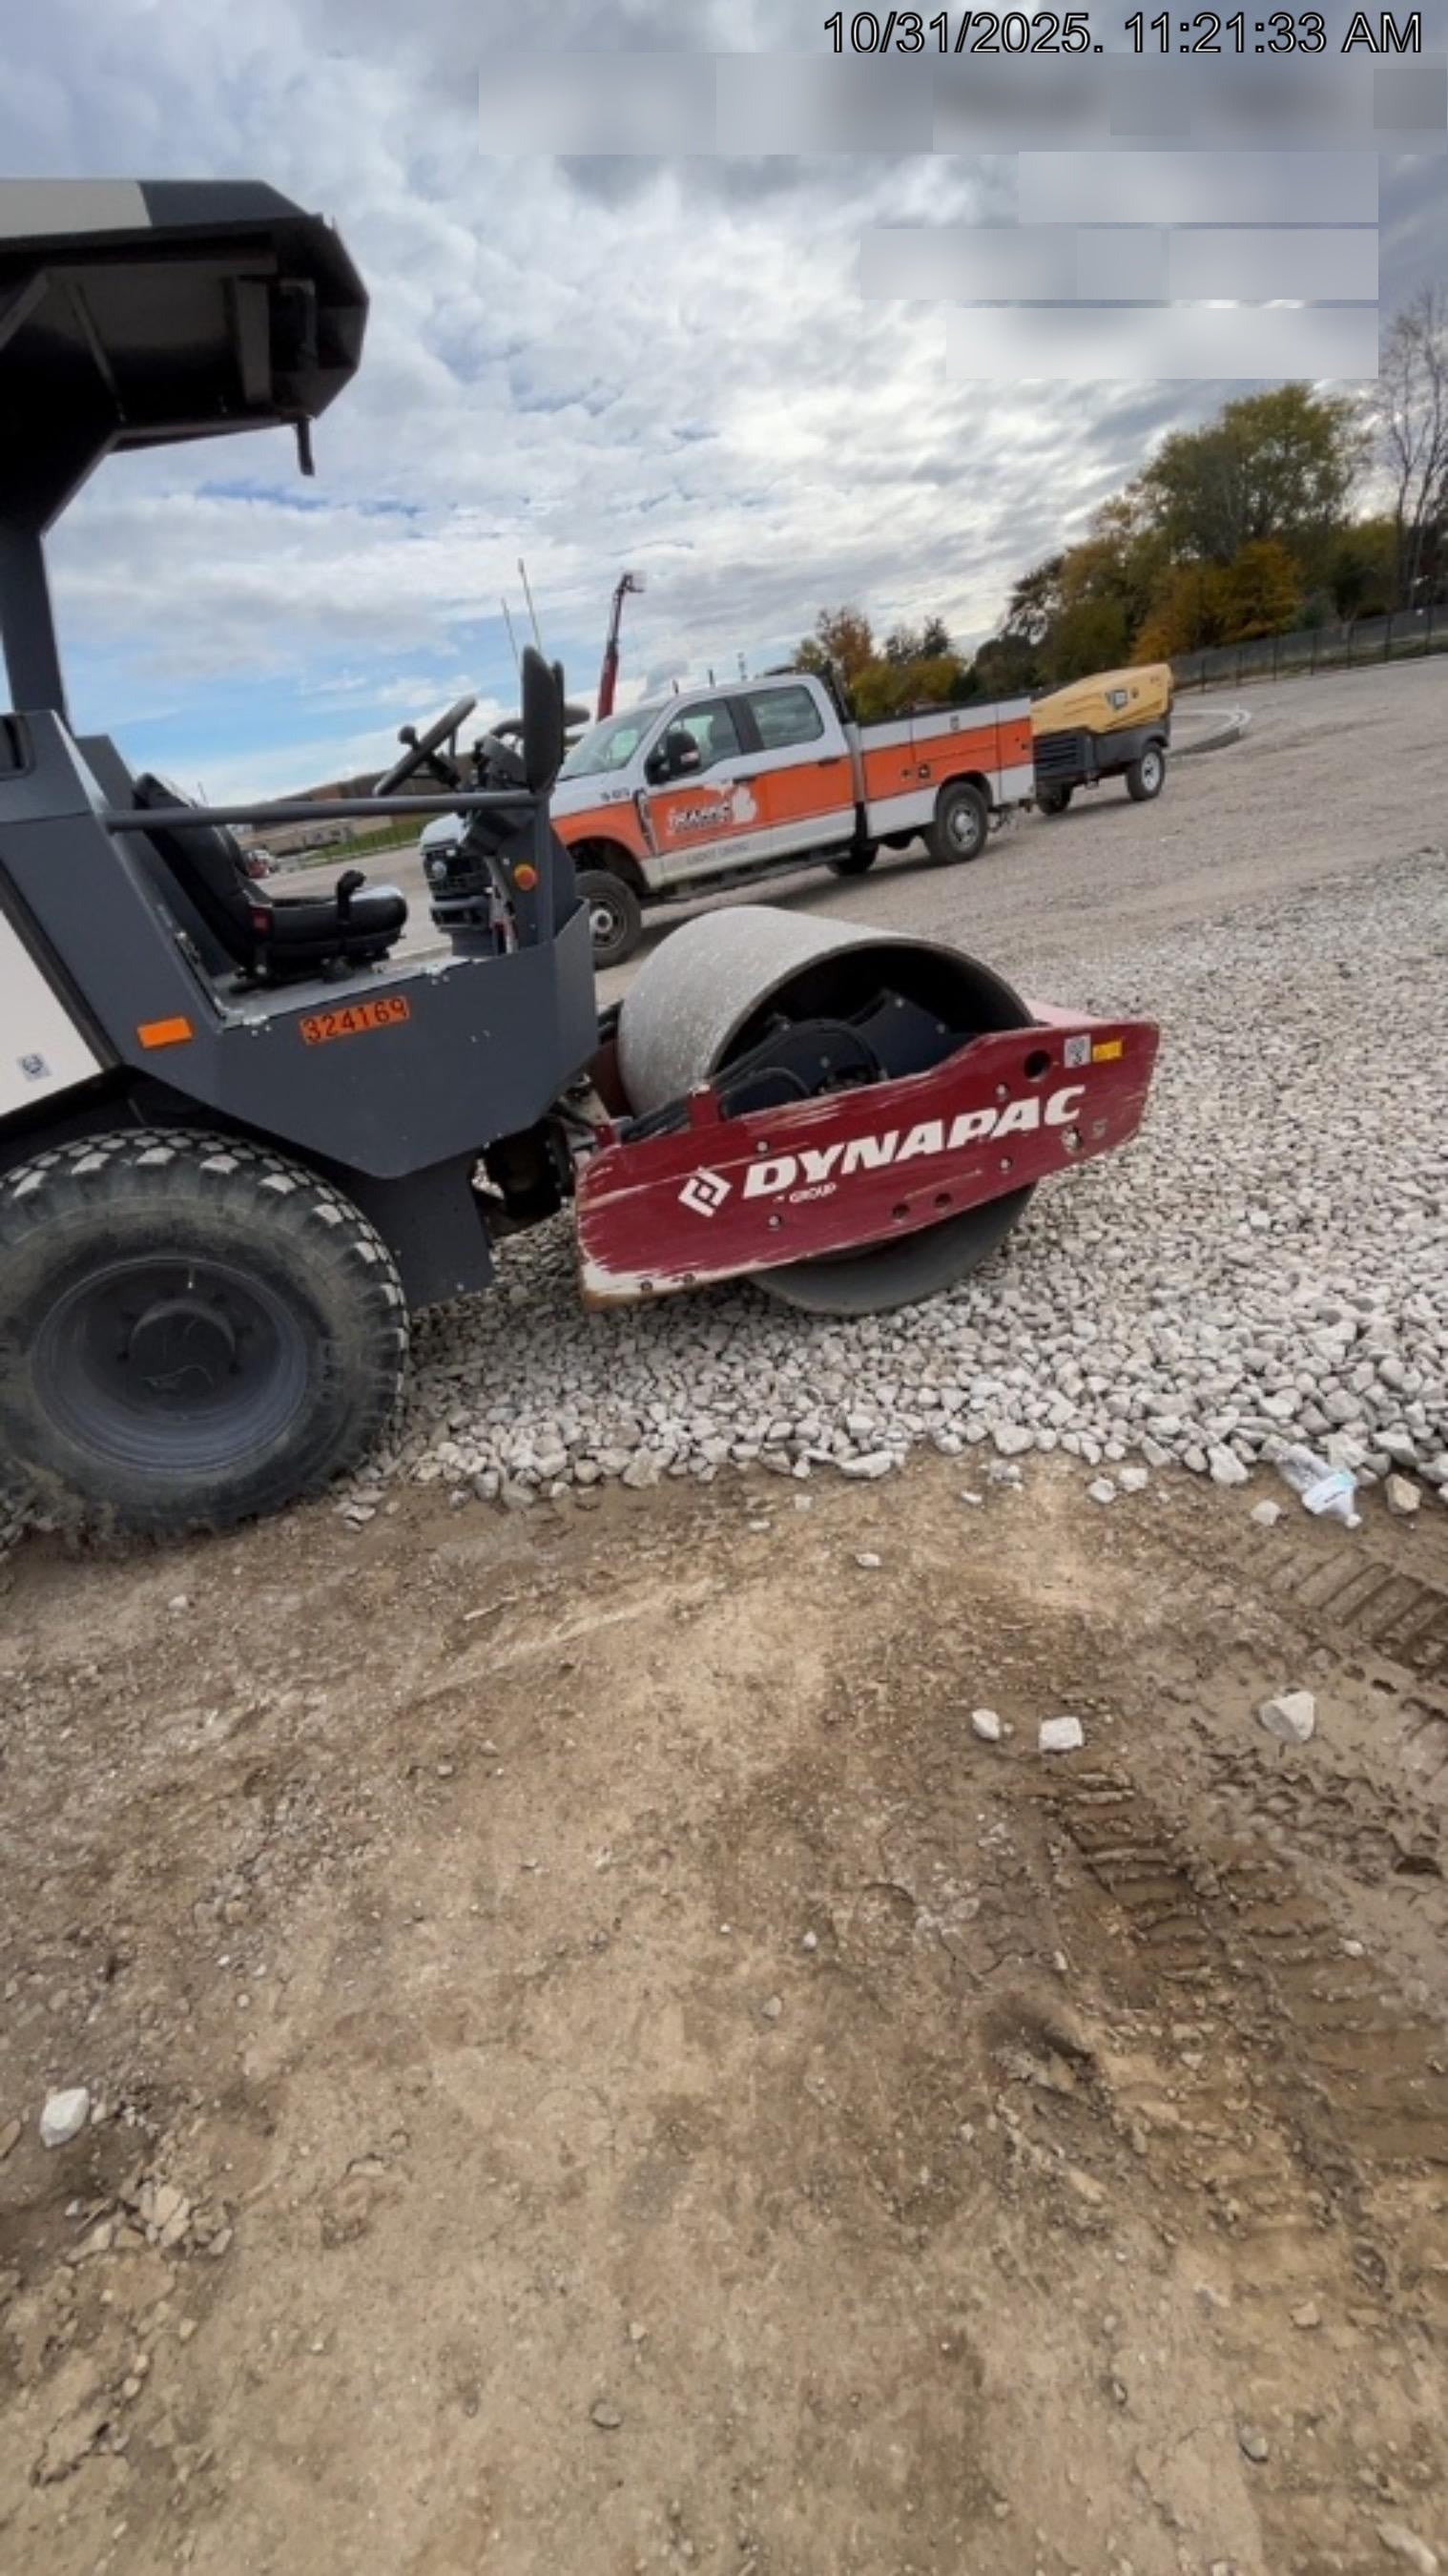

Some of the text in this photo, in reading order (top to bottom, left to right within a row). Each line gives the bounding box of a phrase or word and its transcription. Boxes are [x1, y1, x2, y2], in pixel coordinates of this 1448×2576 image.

[303, 999, 407, 1042] 324169
[743, 1085, 1086, 1198] DYNAPAC
[789, 1181, 838, 1203] GROUP
